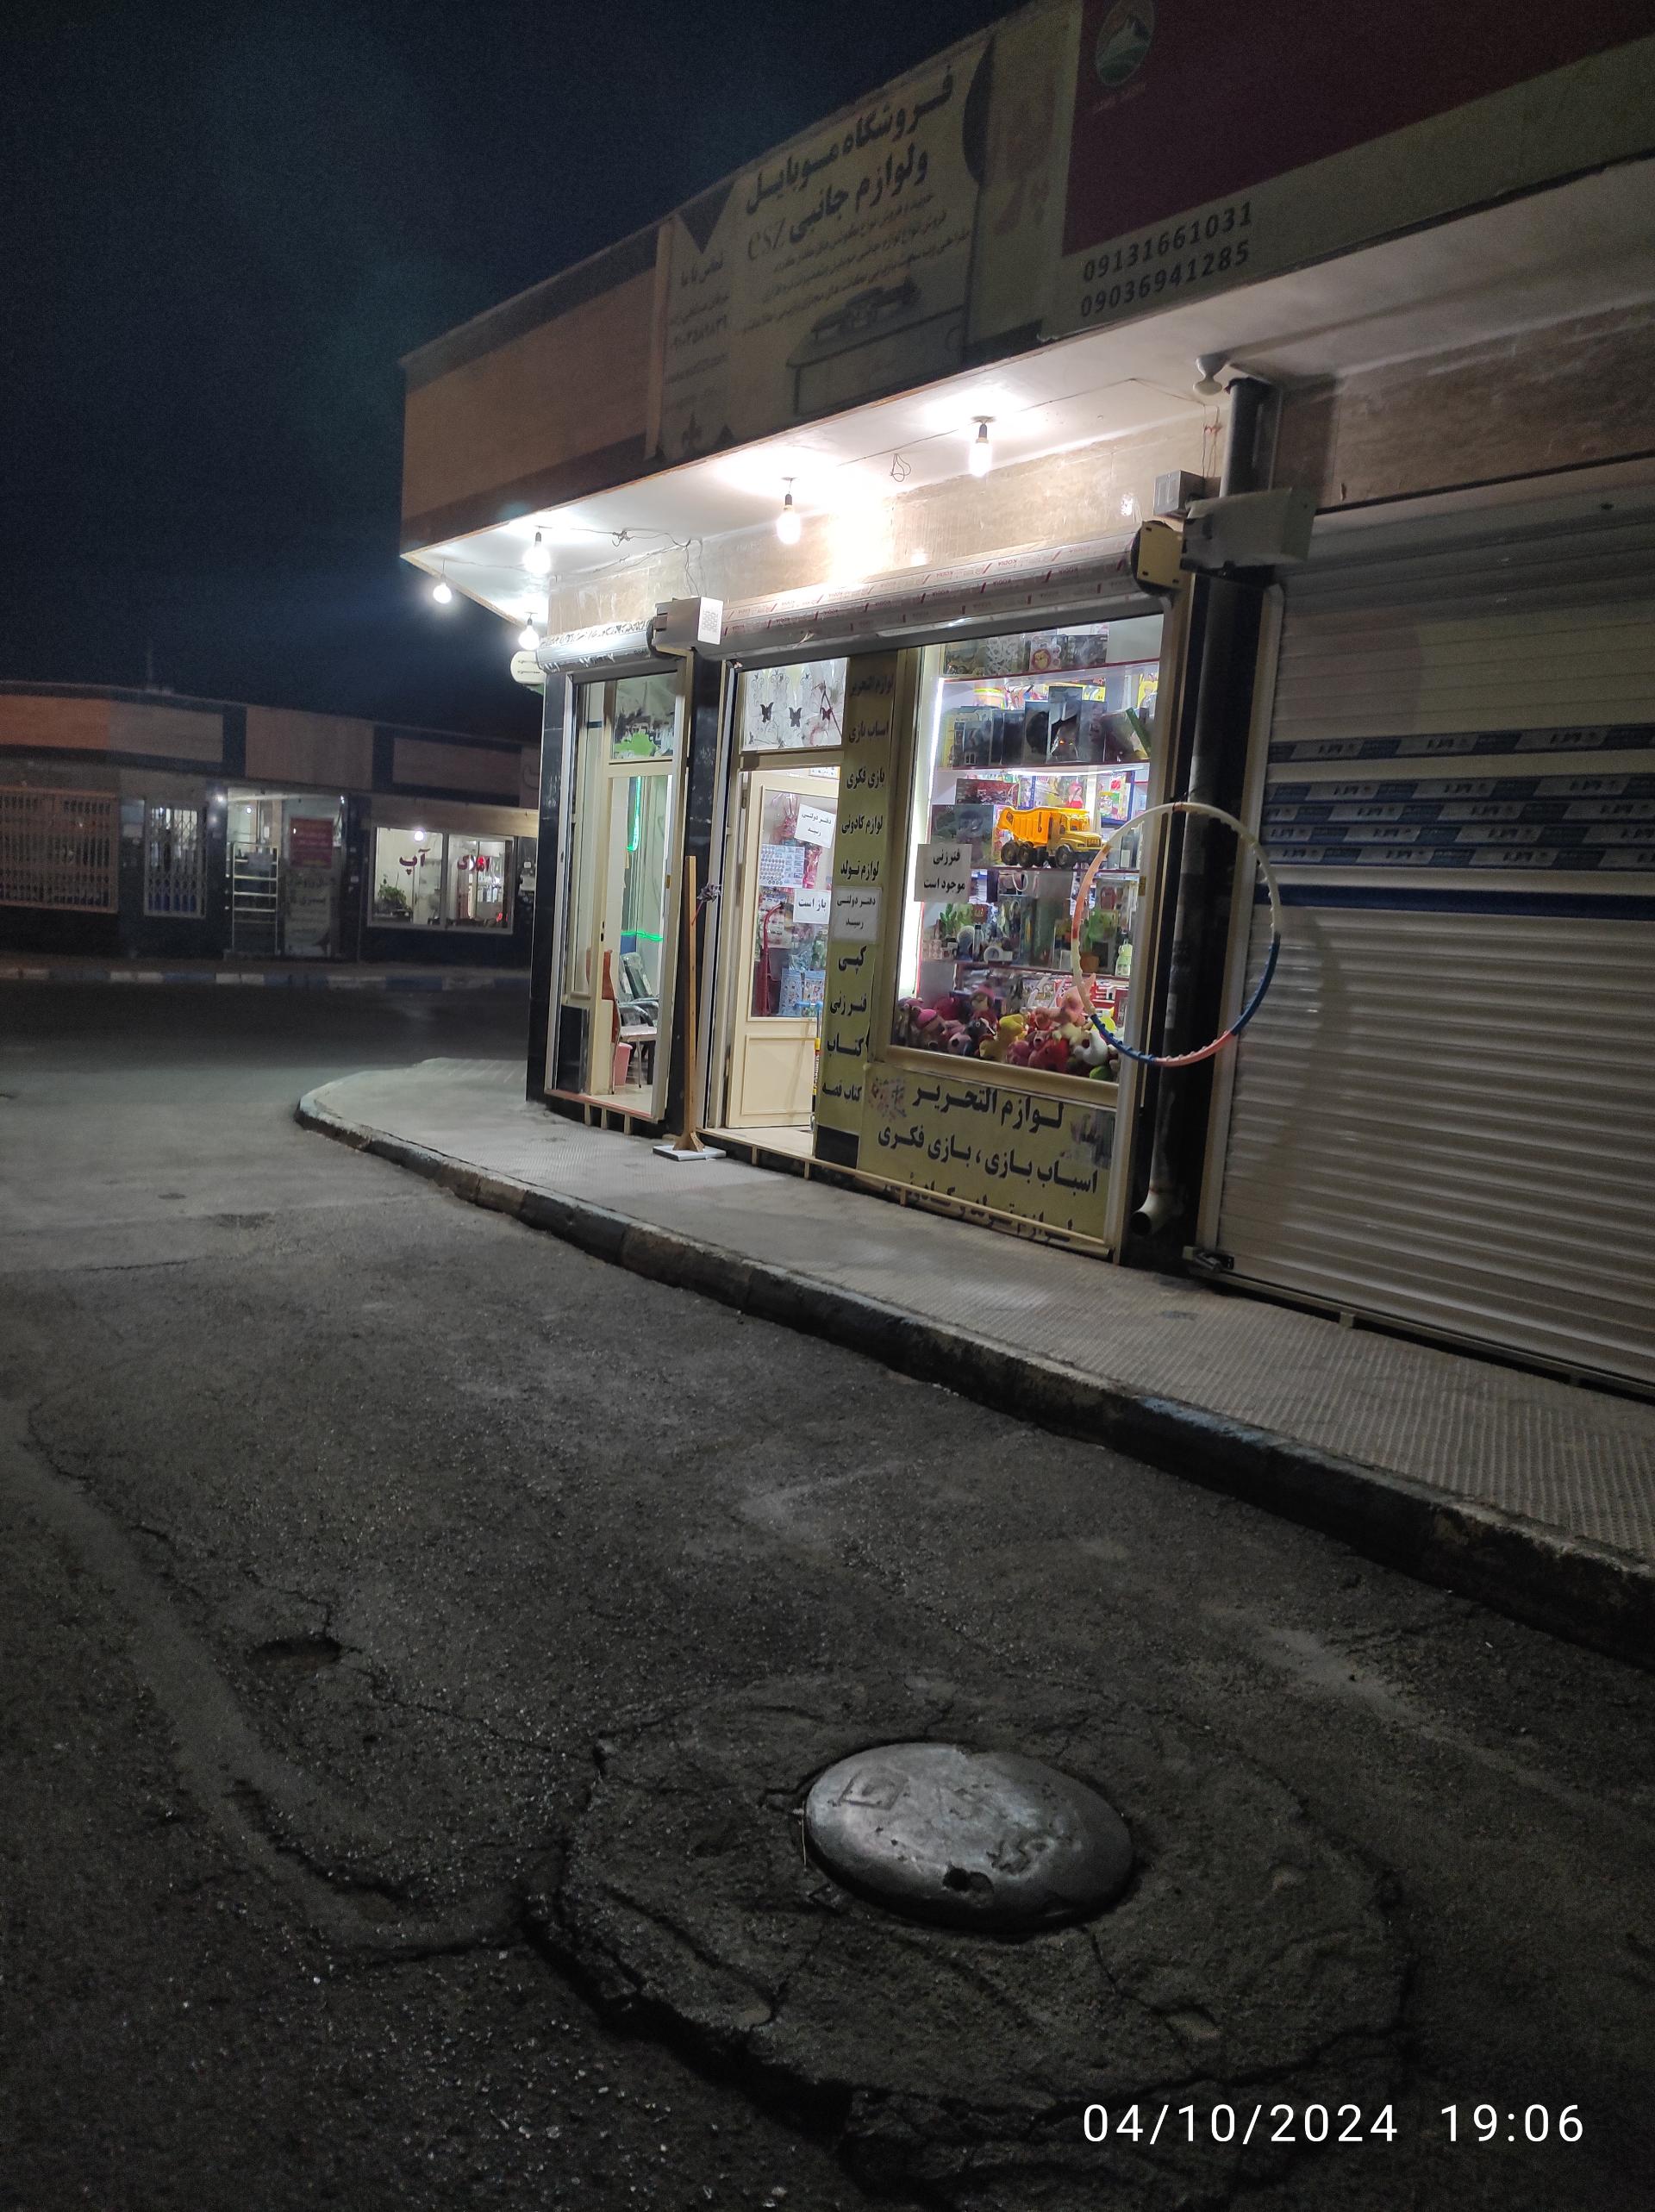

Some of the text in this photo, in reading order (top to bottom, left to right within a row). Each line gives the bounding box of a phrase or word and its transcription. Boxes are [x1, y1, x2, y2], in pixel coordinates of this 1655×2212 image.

[746, 65, 955, 214] فروشگاه موبایل
[790, 185, 848, 244] جانبی
[1084, 201, 1252, 282] 09131661031
[1081, 239, 1250, 317] 09036941285
[848, 720, 890, 743] اسباب بازی
[846, 766, 866, 790] فکری
[867, 766, 885, 788] بازی
[865, 814, 884, 834] لوازم
[399, 848, 430, 875] آپ
[840, 859, 880, 881] لوازم تولد
[923, 877, 965, 894] موجود است
[798, 898, 827, 912] باز است
[837, 895, 876, 908] دفتر دولتی
[846, 917, 864, 929] رسید
[838, 945, 867, 975] کپی
[827, 1033, 864, 1057] کتاب
[843, 1083, 862, 1103] کتاب
[912, 1084, 1065, 1134] لوازم التحریر
[878, 1124, 924, 1150] فکری
[927, 1133, 971, 1168] بازی
[1037, 1159, 1098, 1197] اسباب
